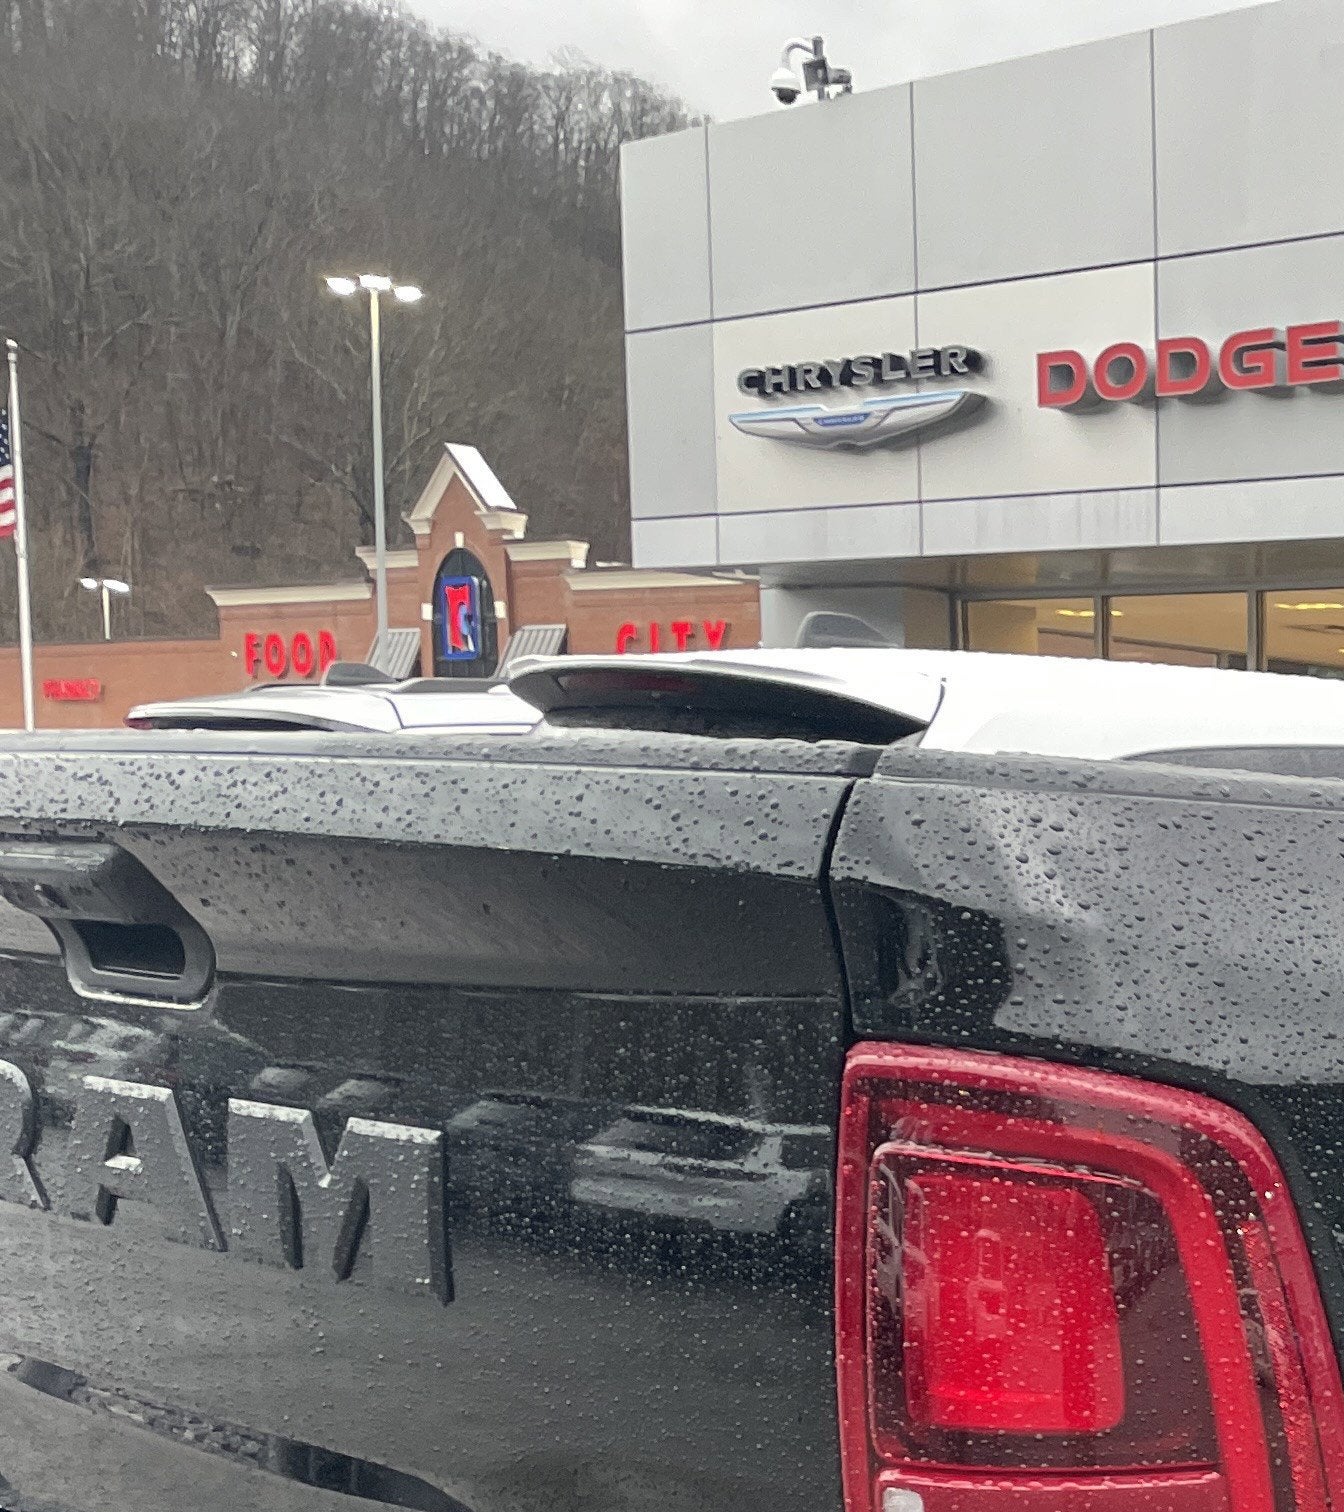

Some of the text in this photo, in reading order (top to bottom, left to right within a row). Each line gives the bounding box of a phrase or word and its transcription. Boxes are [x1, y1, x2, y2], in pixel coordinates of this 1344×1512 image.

[737, 345, 970, 398] CHRYSLER
[244, 620, 727, 677] FOOD CITY
